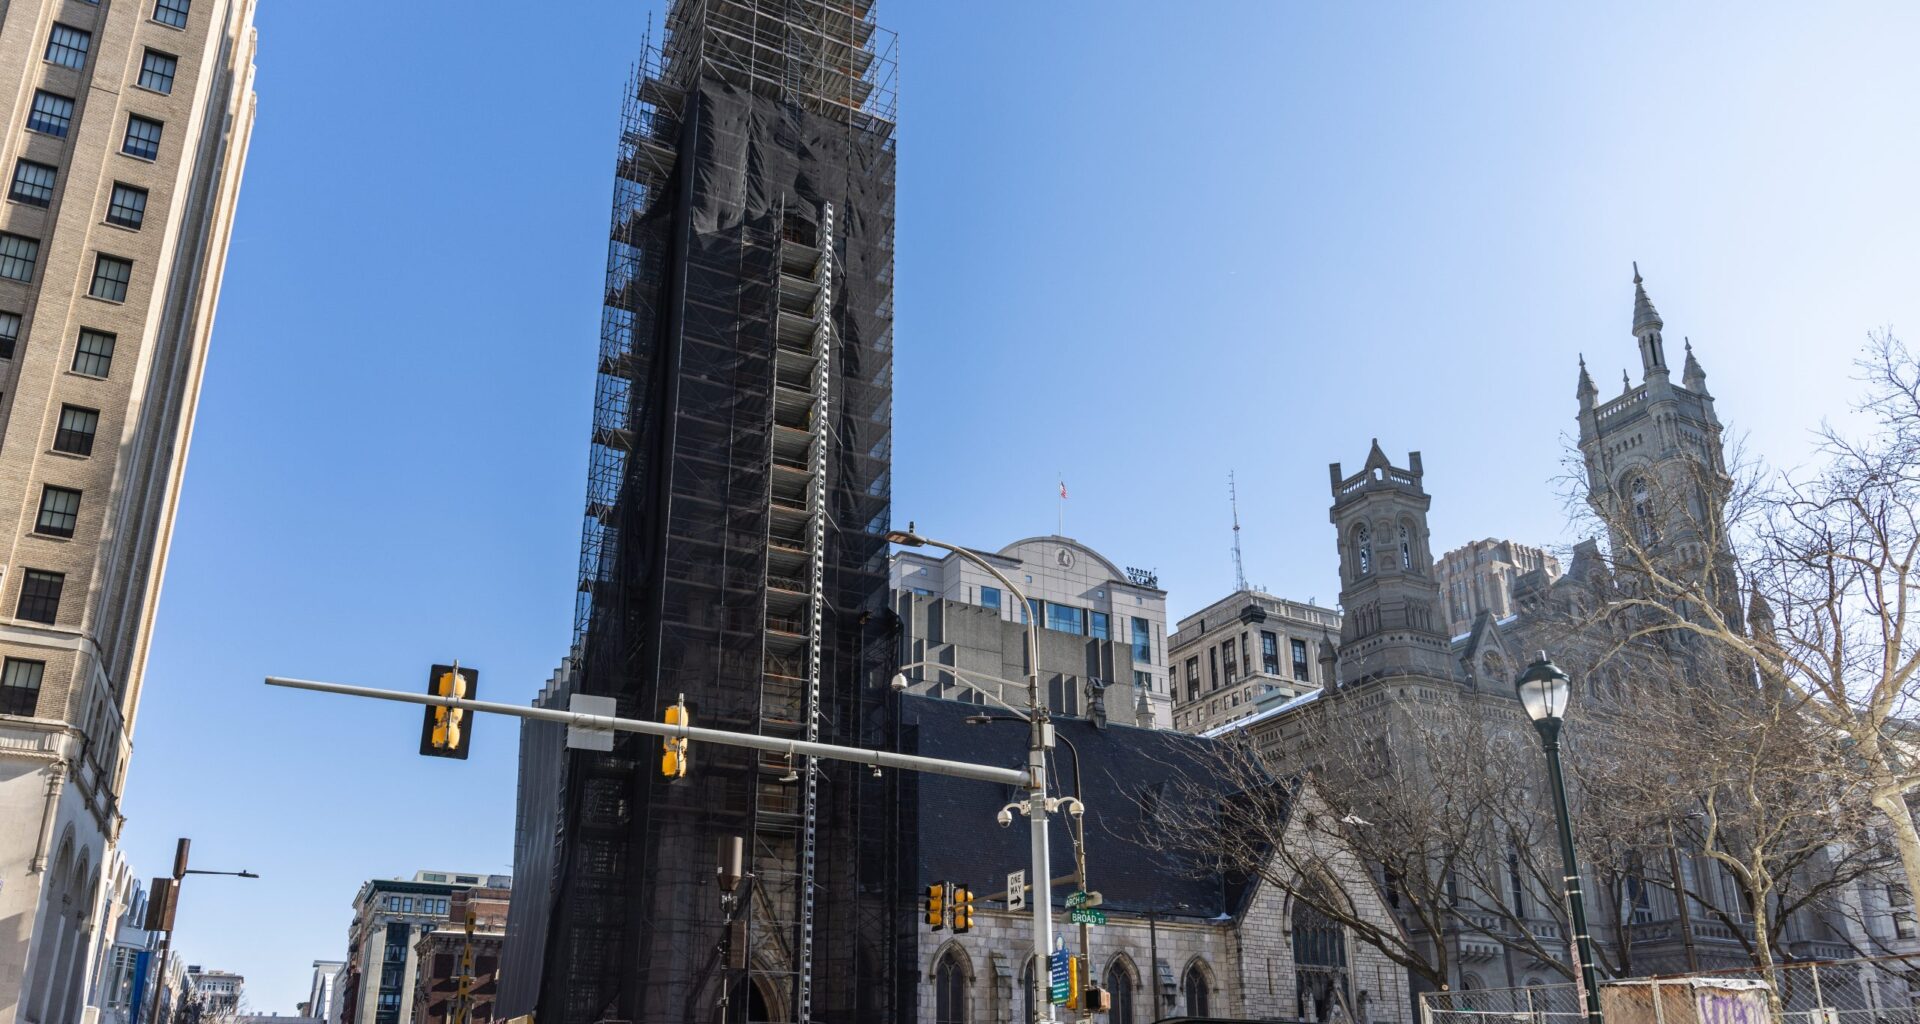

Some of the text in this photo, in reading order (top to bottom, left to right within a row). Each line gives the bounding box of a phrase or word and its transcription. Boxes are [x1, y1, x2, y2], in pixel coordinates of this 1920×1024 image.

[1010, 874, 1022, 885] ONE
[1010, 884, 1022, 895] WAY
[1065, 896, 1080, 909] ARCH
[1072, 912, 1097, 923] BROAD
